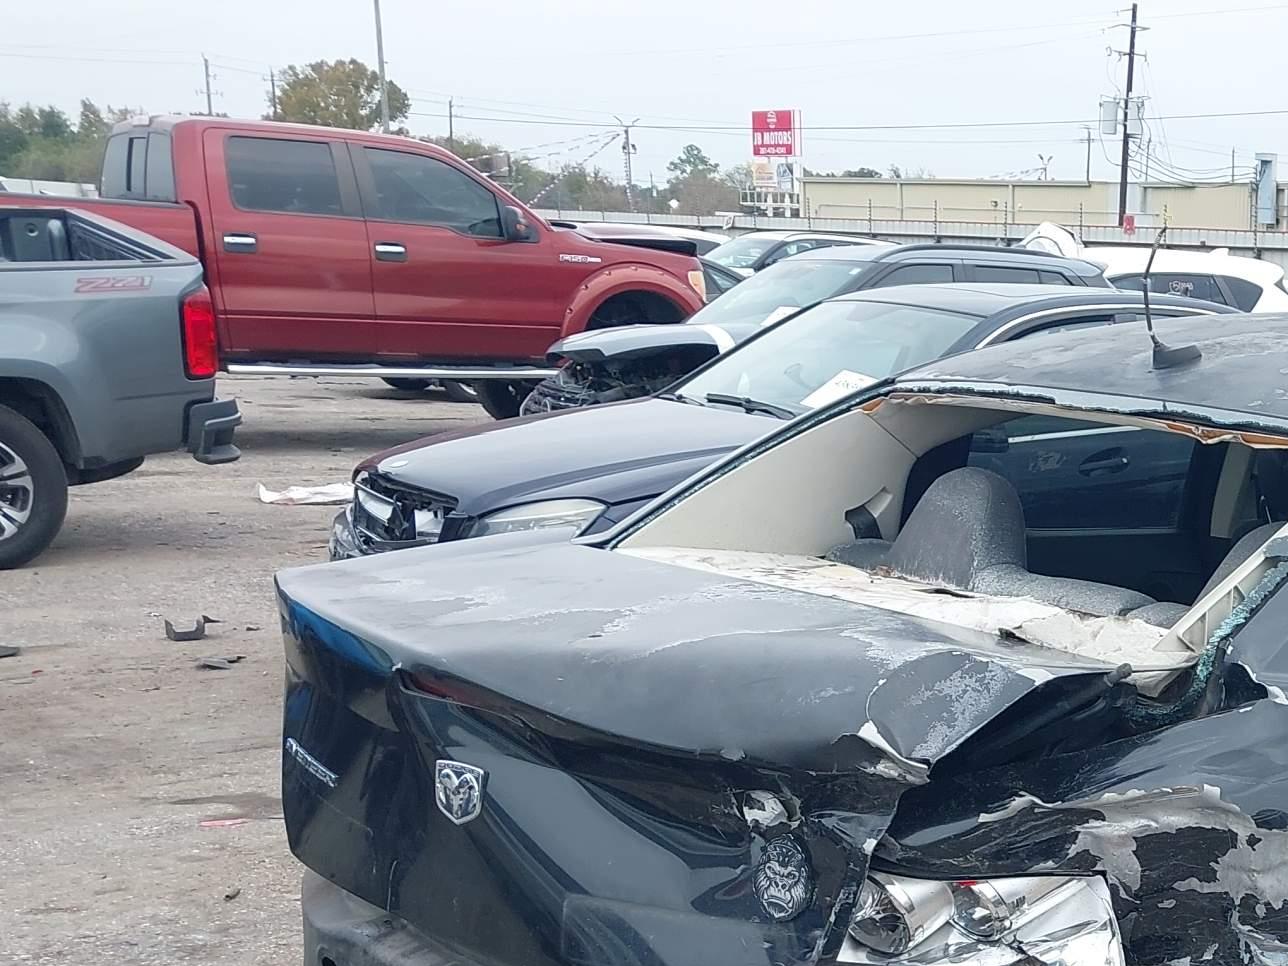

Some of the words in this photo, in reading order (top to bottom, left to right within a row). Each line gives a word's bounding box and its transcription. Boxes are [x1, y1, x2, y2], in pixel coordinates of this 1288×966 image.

[754, 132, 762, 145] JB
[763, 131, 791, 145] MOTORS
[74, 276, 152, 293] Z71
